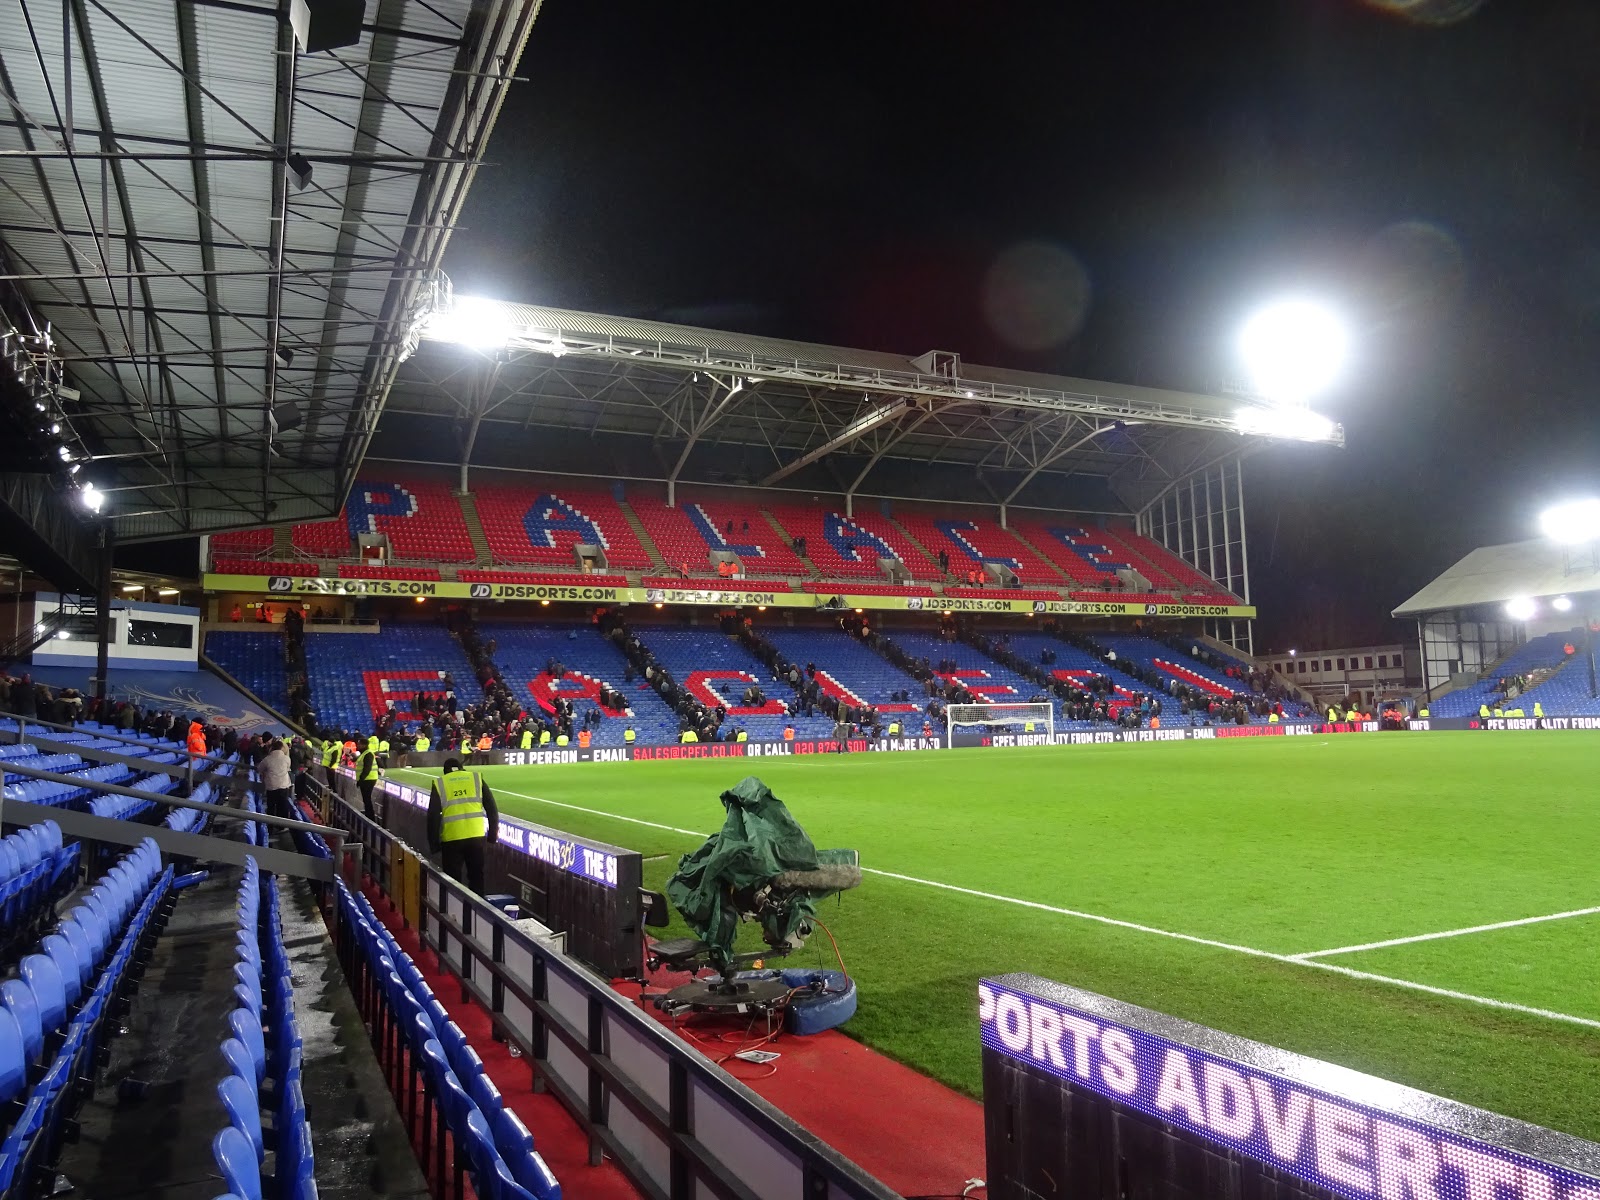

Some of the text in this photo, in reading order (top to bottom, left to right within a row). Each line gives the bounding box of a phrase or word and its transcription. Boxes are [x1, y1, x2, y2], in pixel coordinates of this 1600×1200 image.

[270, 577, 291, 591] JD
[472, 585, 617, 600] JD JDSPORTS.COM
[925, 598, 1011, 610] JDSPORTS.COM
[1034, 601, 1126, 613] JD JDSPORTS.COM
[1145, 604, 1229, 615] JD JDSPORTS.COM
[1363, 721, 1378, 732] FOR
[1409, 720, 1430, 731] INFO
[1481, 716, 1600, 730] PFC HOSPIALITY FROM
[992, 735, 1015, 748] CPFC
[1071, 732, 1093, 744] FROM
[1095, 731, 1114, 743] £179
[1122, 730, 1138, 742] VAT
[1139, 730, 1154, 742] PER
[1155, 729, 1185, 741] PERSON
[1193, 728, 1215, 739] EMAIL
[1217, 726, 1284, 738] SALES@CPFC.CO.UK
[1286, 724, 1295, 736] OR
[1296, 723, 1313, 735] CALL
[530, 750, 578, 765] PERSON
[593, 748, 629, 763] EMAIL
[633, 744, 744, 761] SALES@CPFC.CO.UK
[747, 744, 762, 756] OR
[765, 743, 791, 756] CALL
[795, 742, 814, 754] 020
[453, 789, 467, 797] 231
[583, 848, 605, 880] THE
